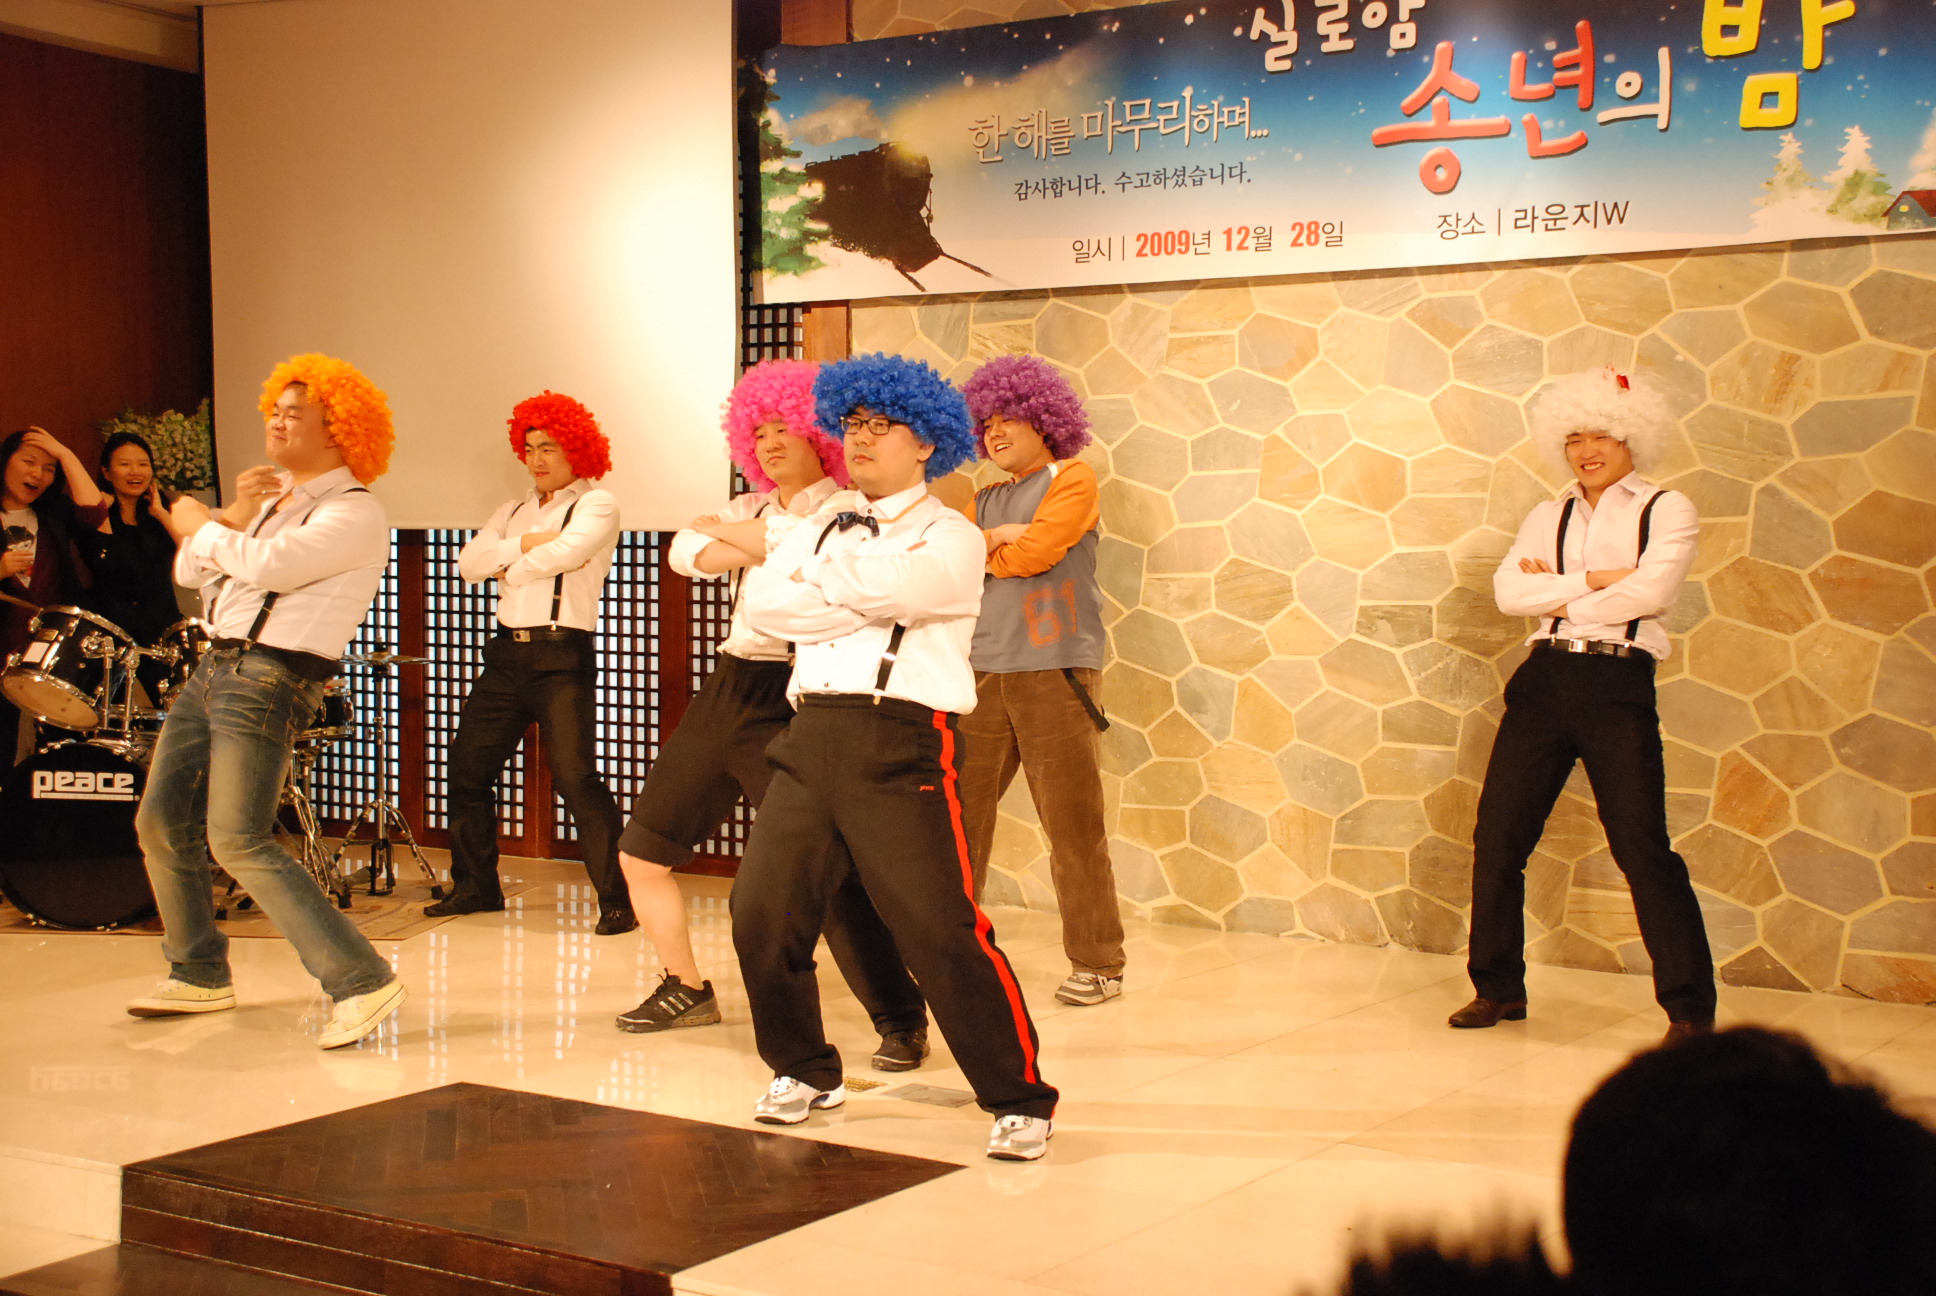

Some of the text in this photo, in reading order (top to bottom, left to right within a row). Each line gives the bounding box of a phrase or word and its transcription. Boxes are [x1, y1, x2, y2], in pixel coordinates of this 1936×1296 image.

[1250, 0, 1426, 72] 실로암
[1371, 0, 1855, 194] 송년의 밤
[968, 114, 1008, 163] 한
[1011, 107, 1076, 160] 해를
[1014, 161, 1252, 201] 감사합니다. 수고하셨습니다.
[1071, 220, 1344, 264] 일시 2009년 12월 28일
[1436, 200, 1630, 241] 장소 라운지W
[1022, 579, 1077, 648] 61
[32, 770, 135, 799] peace
